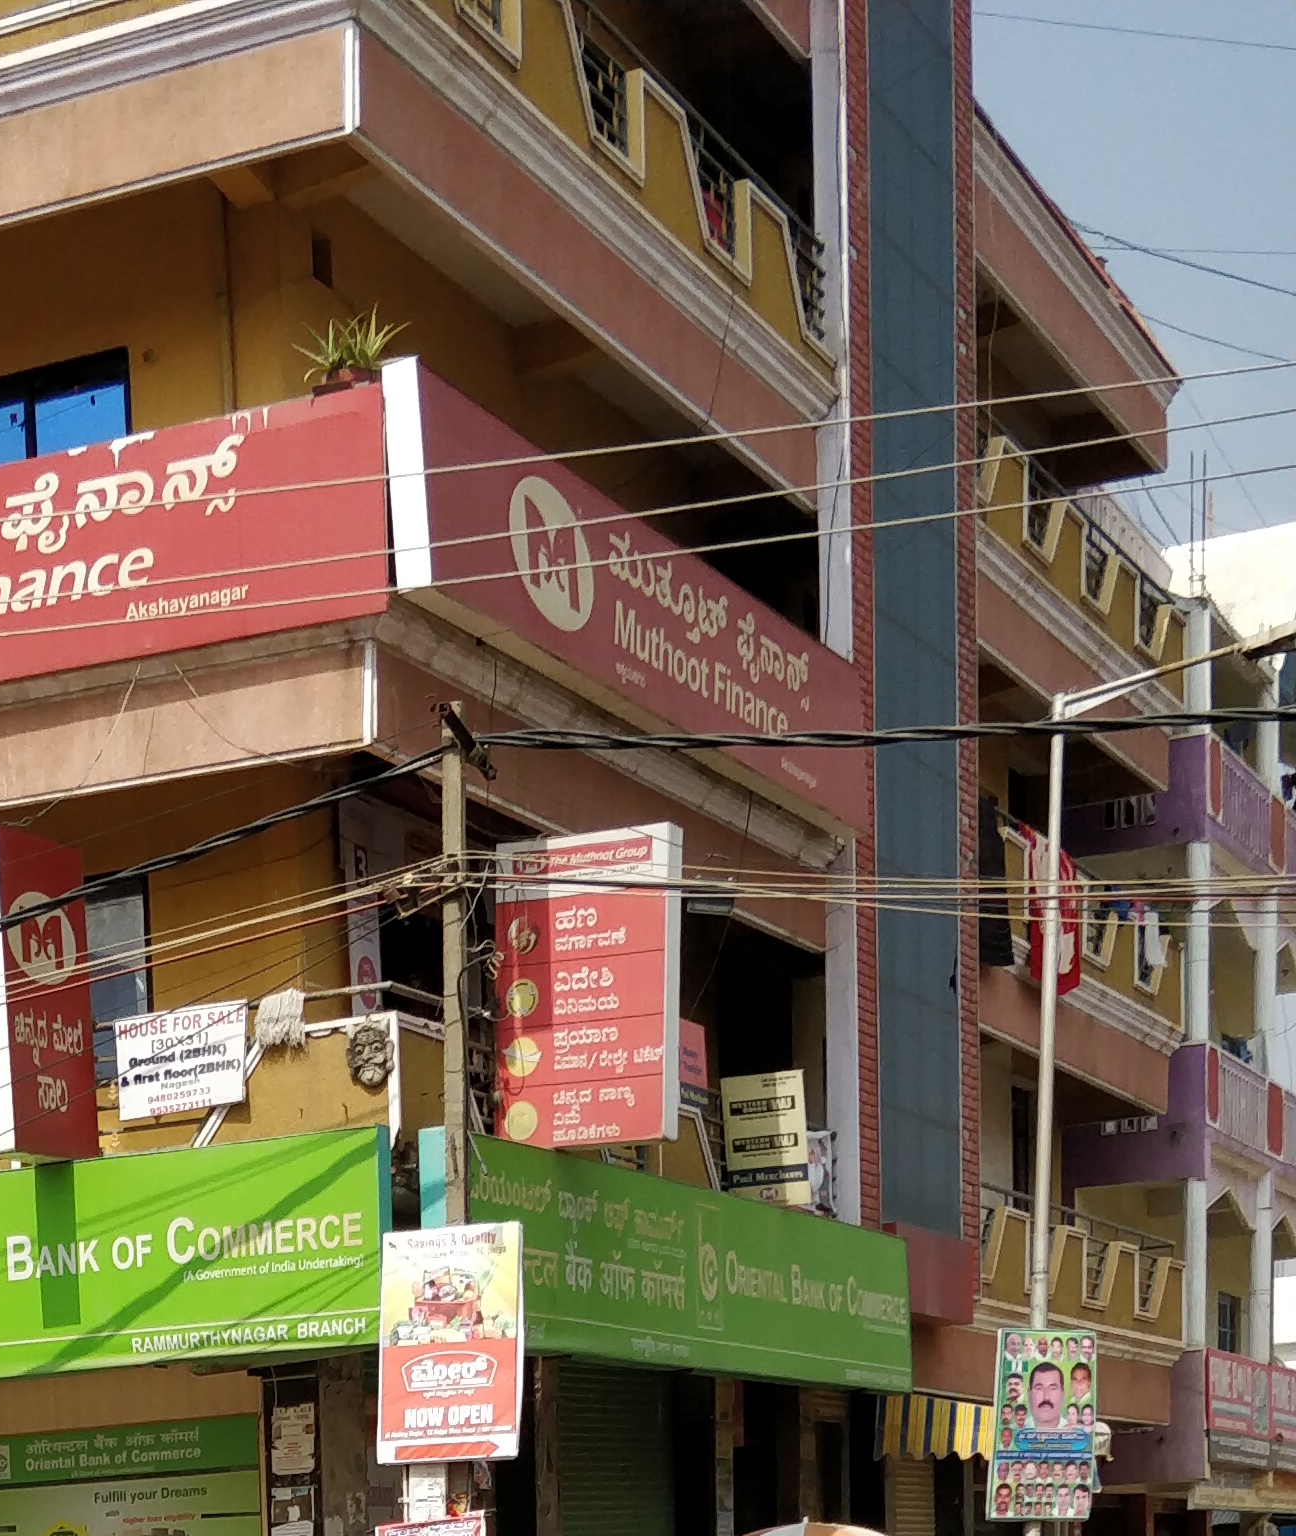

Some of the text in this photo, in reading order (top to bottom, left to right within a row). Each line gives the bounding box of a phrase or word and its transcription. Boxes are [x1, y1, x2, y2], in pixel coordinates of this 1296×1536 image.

[1, 433, 246, 556] ಫೈನಾನ್ಸ್
[125, 585, 249, 621] Akshayanagar
[614, 600, 789, 736] Muthoot Finance
[615, 845, 648, 858] Group
[555, 905, 598, 930] ಹಣ
[554, 966, 614, 992] ವಿದೇಶಿ
[554, 993, 619, 1015] ವಿನಿಮಯ
[118, 1008, 244, 1041] HOUSE FOR SALE
[553, 1026, 619, 1054] ಪ್ರಯಾಣ
[128, 1043, 227, 1068] Ground (2BHK)
[121, 1072, 160, 1087] & first
[37, 1074, 68, 1112] ಸಾಲ
[6, 1235, 100, 1281] BANK
[111, 1233, 152, 1270] OF
[167, 1211, 364, 1265] COMMERCE
[195, 1266, 257, 1281] Government
[259, 1262, 271, 1274] of
[271, 1260, 296, 1273] India
[132, 1317, 366, 1354] RAMMURTHYNAGAR BRANCH
[404, 1403, 493, 1428] NOW OPEN
[25, 1448, 201, 1472] Oriental Bank of Commerce
[94, 1485, 208, 1504] Fulfill your Dreams
